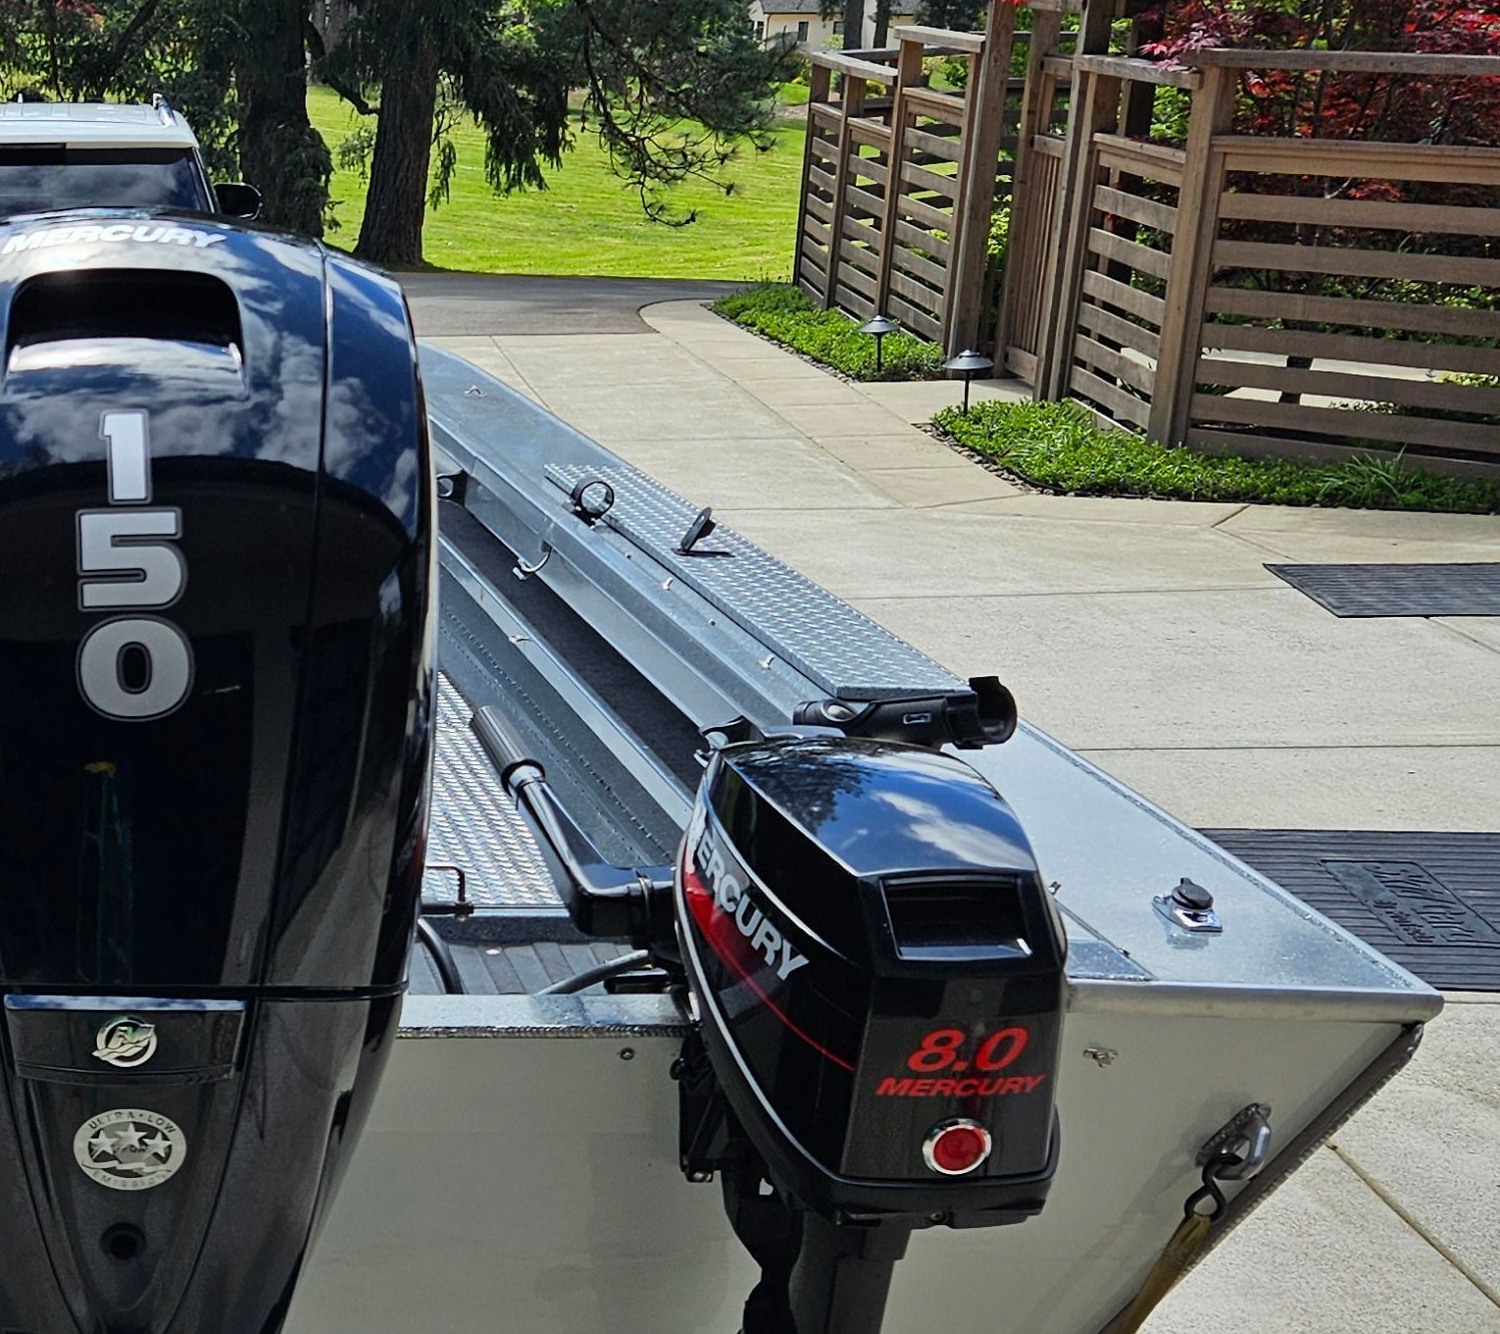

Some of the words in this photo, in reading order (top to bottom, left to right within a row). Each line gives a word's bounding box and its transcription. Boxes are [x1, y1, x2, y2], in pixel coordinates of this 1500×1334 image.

[1, 224, 228, 255] MERCURY
[77, 409, 193, 720] 150
[695, 821, 810, 981] ERCURY
[907, 1027, 1029, 1072] 8.0
[875, 1074, 1046, 1097] MERCURY
